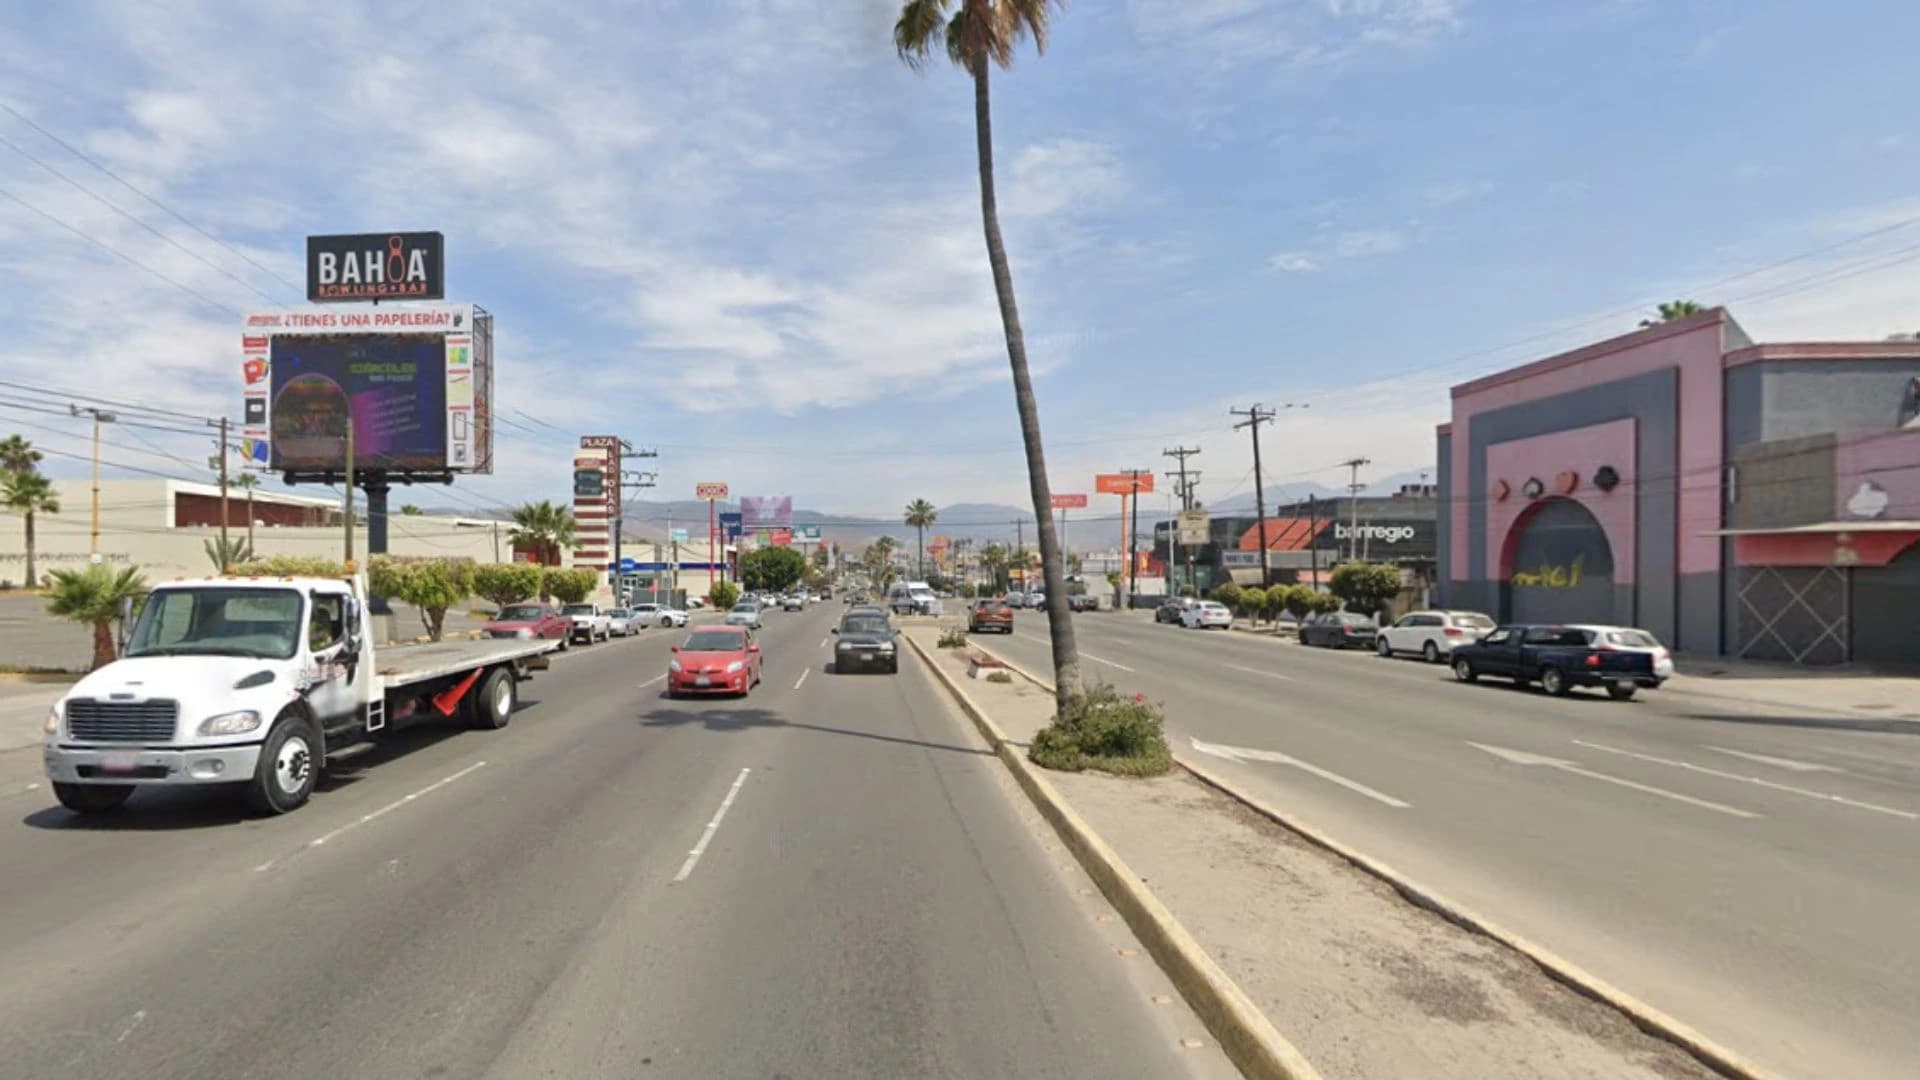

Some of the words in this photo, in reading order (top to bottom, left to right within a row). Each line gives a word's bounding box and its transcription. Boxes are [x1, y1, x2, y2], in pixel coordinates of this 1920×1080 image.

[318, 283, 388, 297] BOWLING
[399, 282, 428, 295] BAR
[284, 313, 337, 327] ¿TIENES
[341, 313, 371, 327] UNA
[374, 309, 450, 326] PAPELERÍA?
[582, 438, 614, 448] PLAZA
